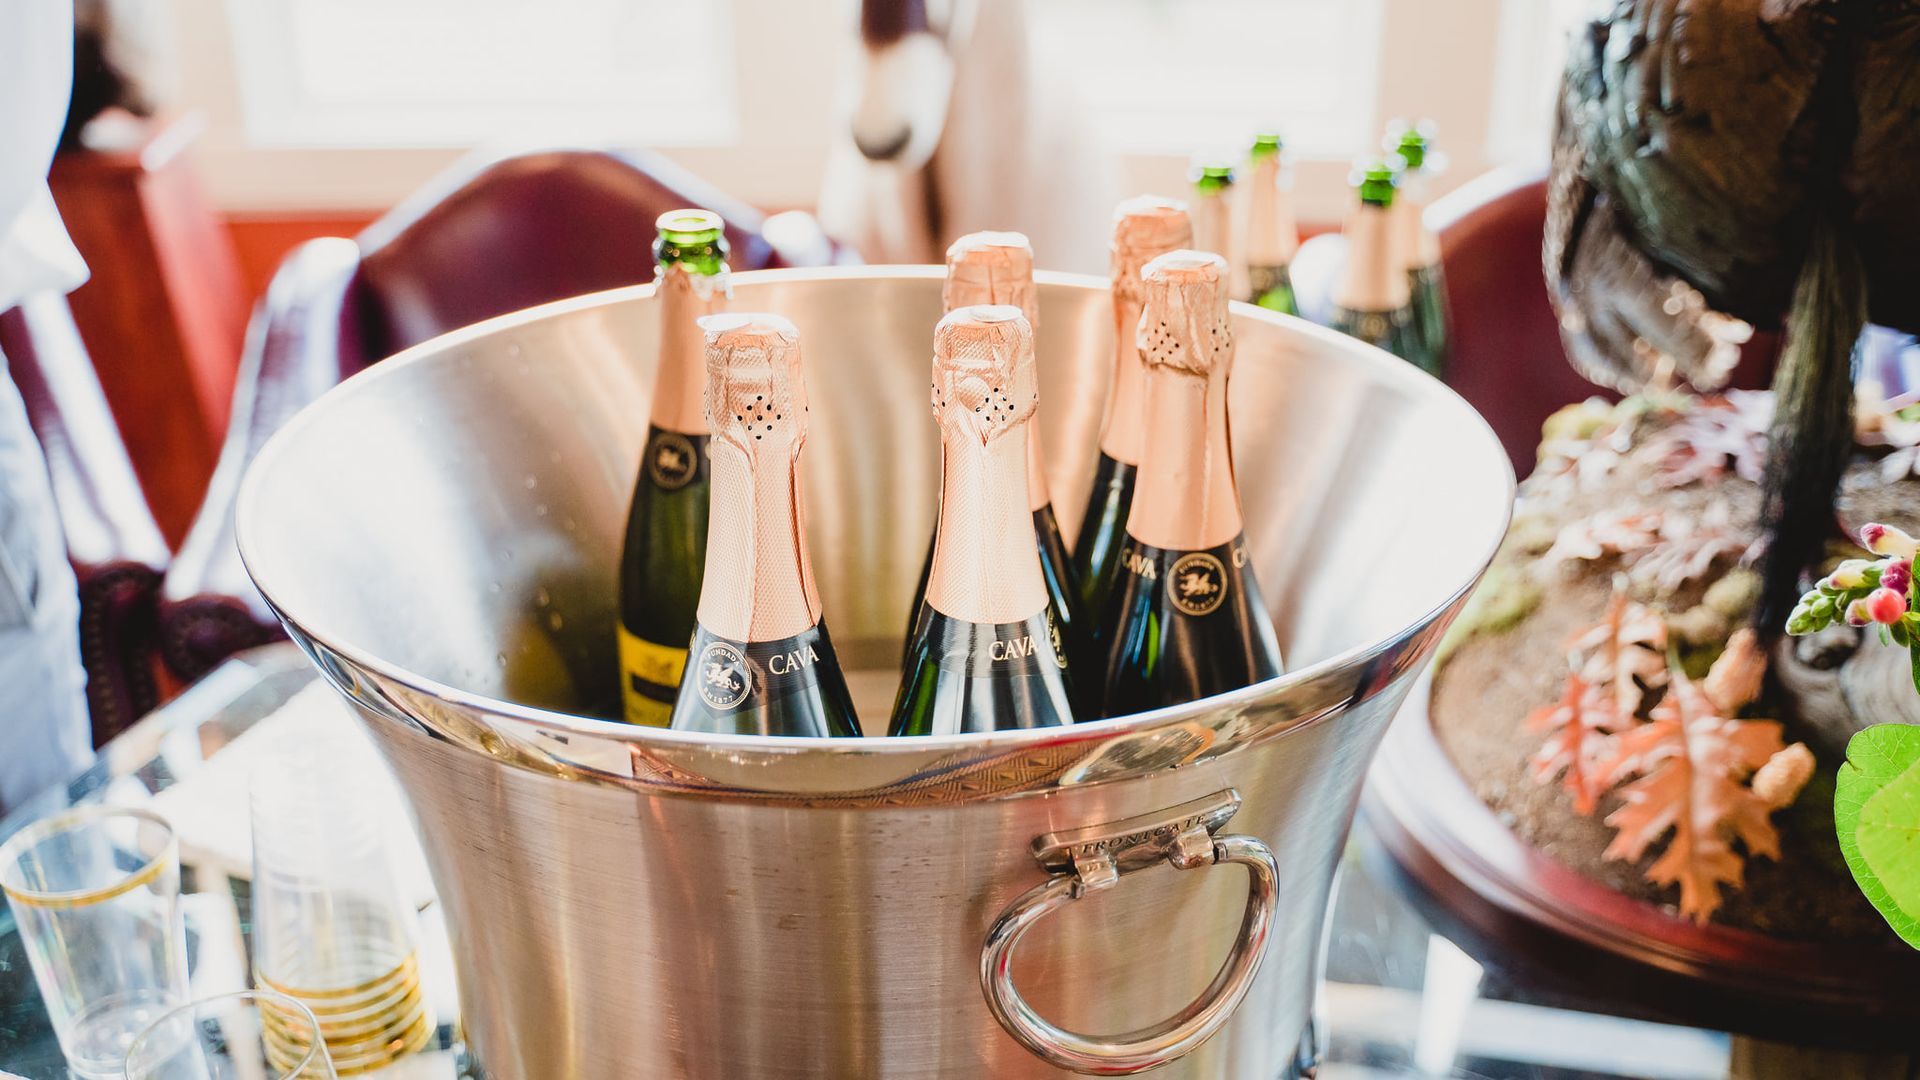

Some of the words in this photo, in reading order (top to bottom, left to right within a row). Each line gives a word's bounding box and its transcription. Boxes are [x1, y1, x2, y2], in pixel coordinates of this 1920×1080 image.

[1121, 547, 1157, 581] CAVA
[768, 644, 820, 675] CAVA
[988, 634, 1040, 661] CAVA
[1082, 814, 1206, 855] FRONTGATE
